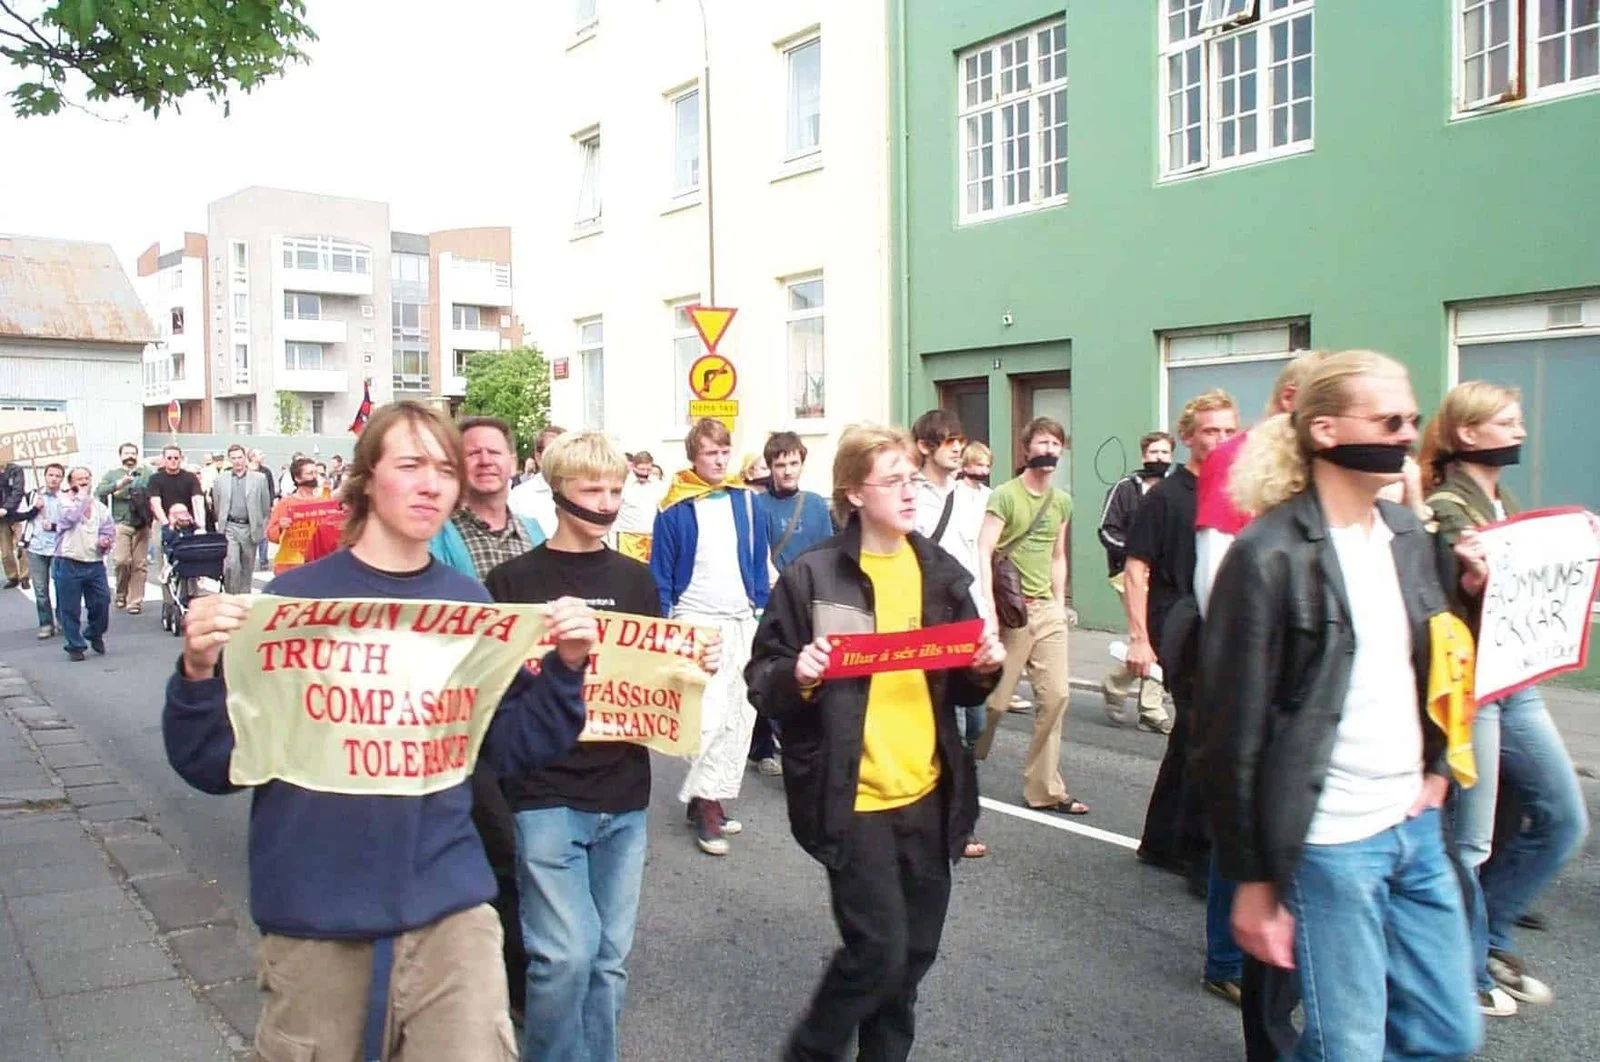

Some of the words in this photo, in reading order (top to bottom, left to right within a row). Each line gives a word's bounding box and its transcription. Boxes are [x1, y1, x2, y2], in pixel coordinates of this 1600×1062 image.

[13, 439, 68, 460] KILLS
[264, 600, 404, 631] FALUN
[412, 602, 520, 643] DAFA
[617, 619, 696, 659] DAFA
[257, 639, 390, 675] TRUTH
[581, 679, 682, 713] PASSION
[588, 709, 680, 742] LERANCE
